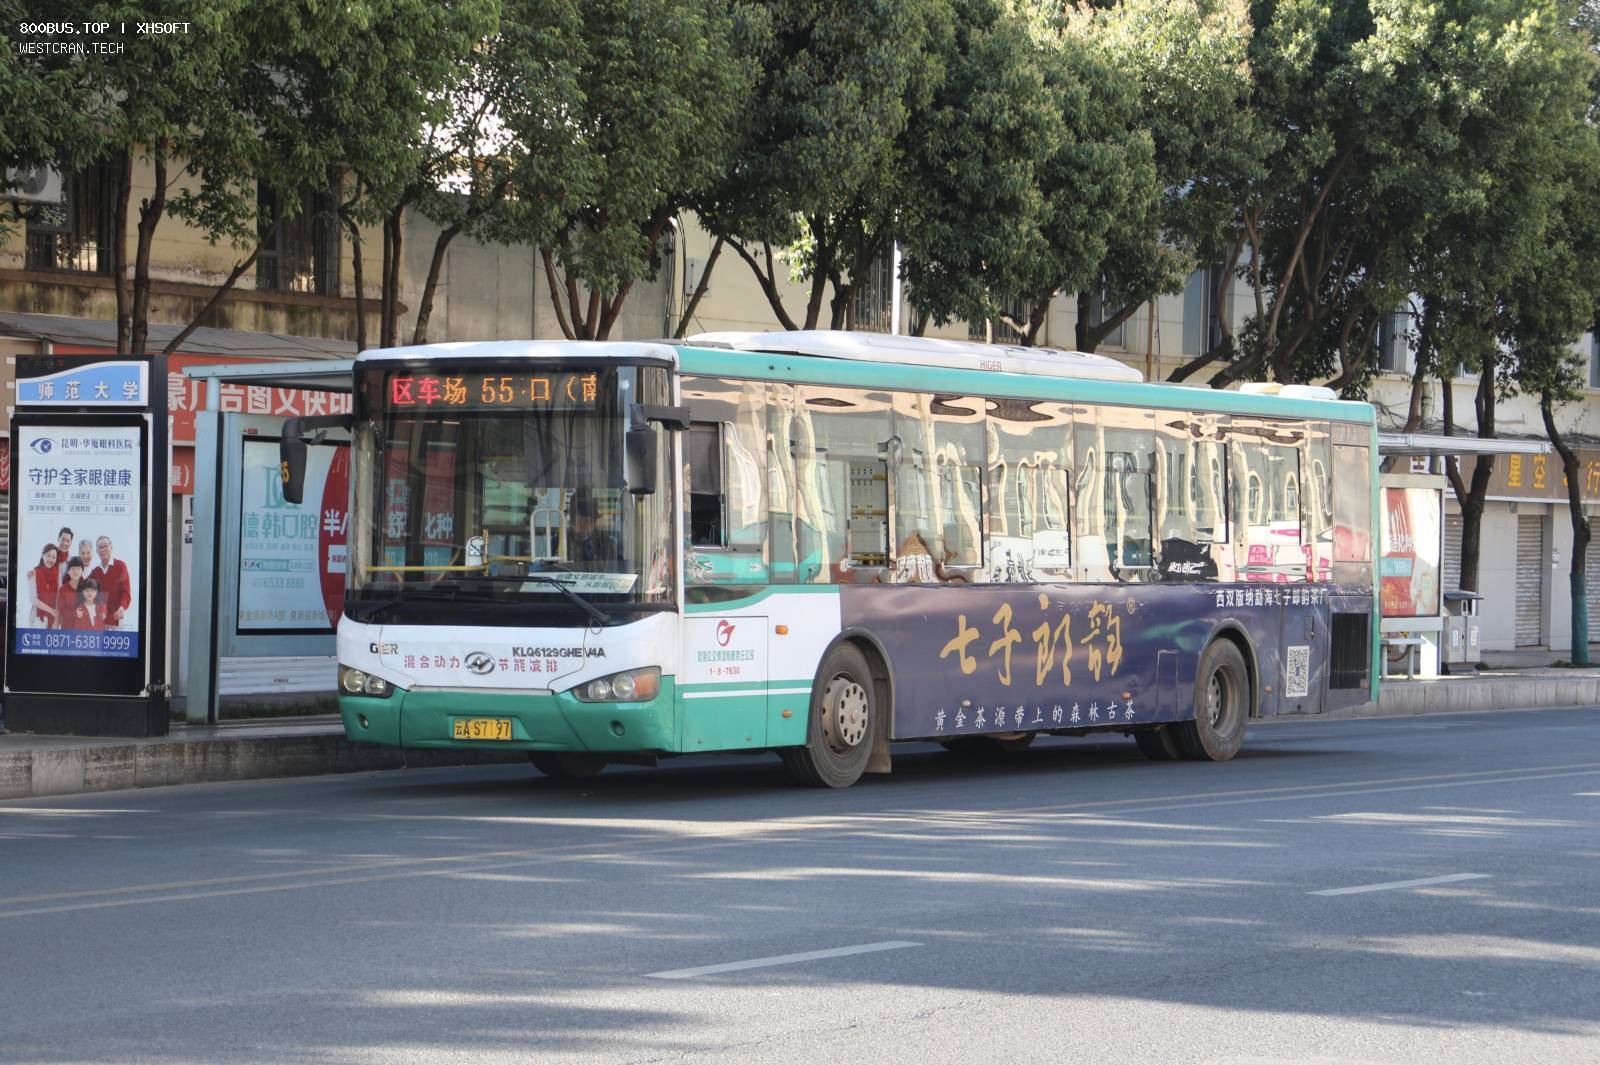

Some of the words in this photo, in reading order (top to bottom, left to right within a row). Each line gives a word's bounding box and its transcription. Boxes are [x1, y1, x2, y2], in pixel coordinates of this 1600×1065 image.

[38, 380, 139, 400] 师范大学
[391, 376, 467, 405] 区车场
[481, 377, 514, 403] 55
[28, 467, 132, 487] 守护全家眼健康
[243, 512, 318, 539] 德韩口腔
[45, 634, 100, 649] 0871-6381
[103, 635, 130, 650] 9999
[404, 655, 460, 669] 混合动力
[499, 658, 558, 672] 节能减排
[935, 699, 1136, 732] 黄金茶源带上的森林古茶
